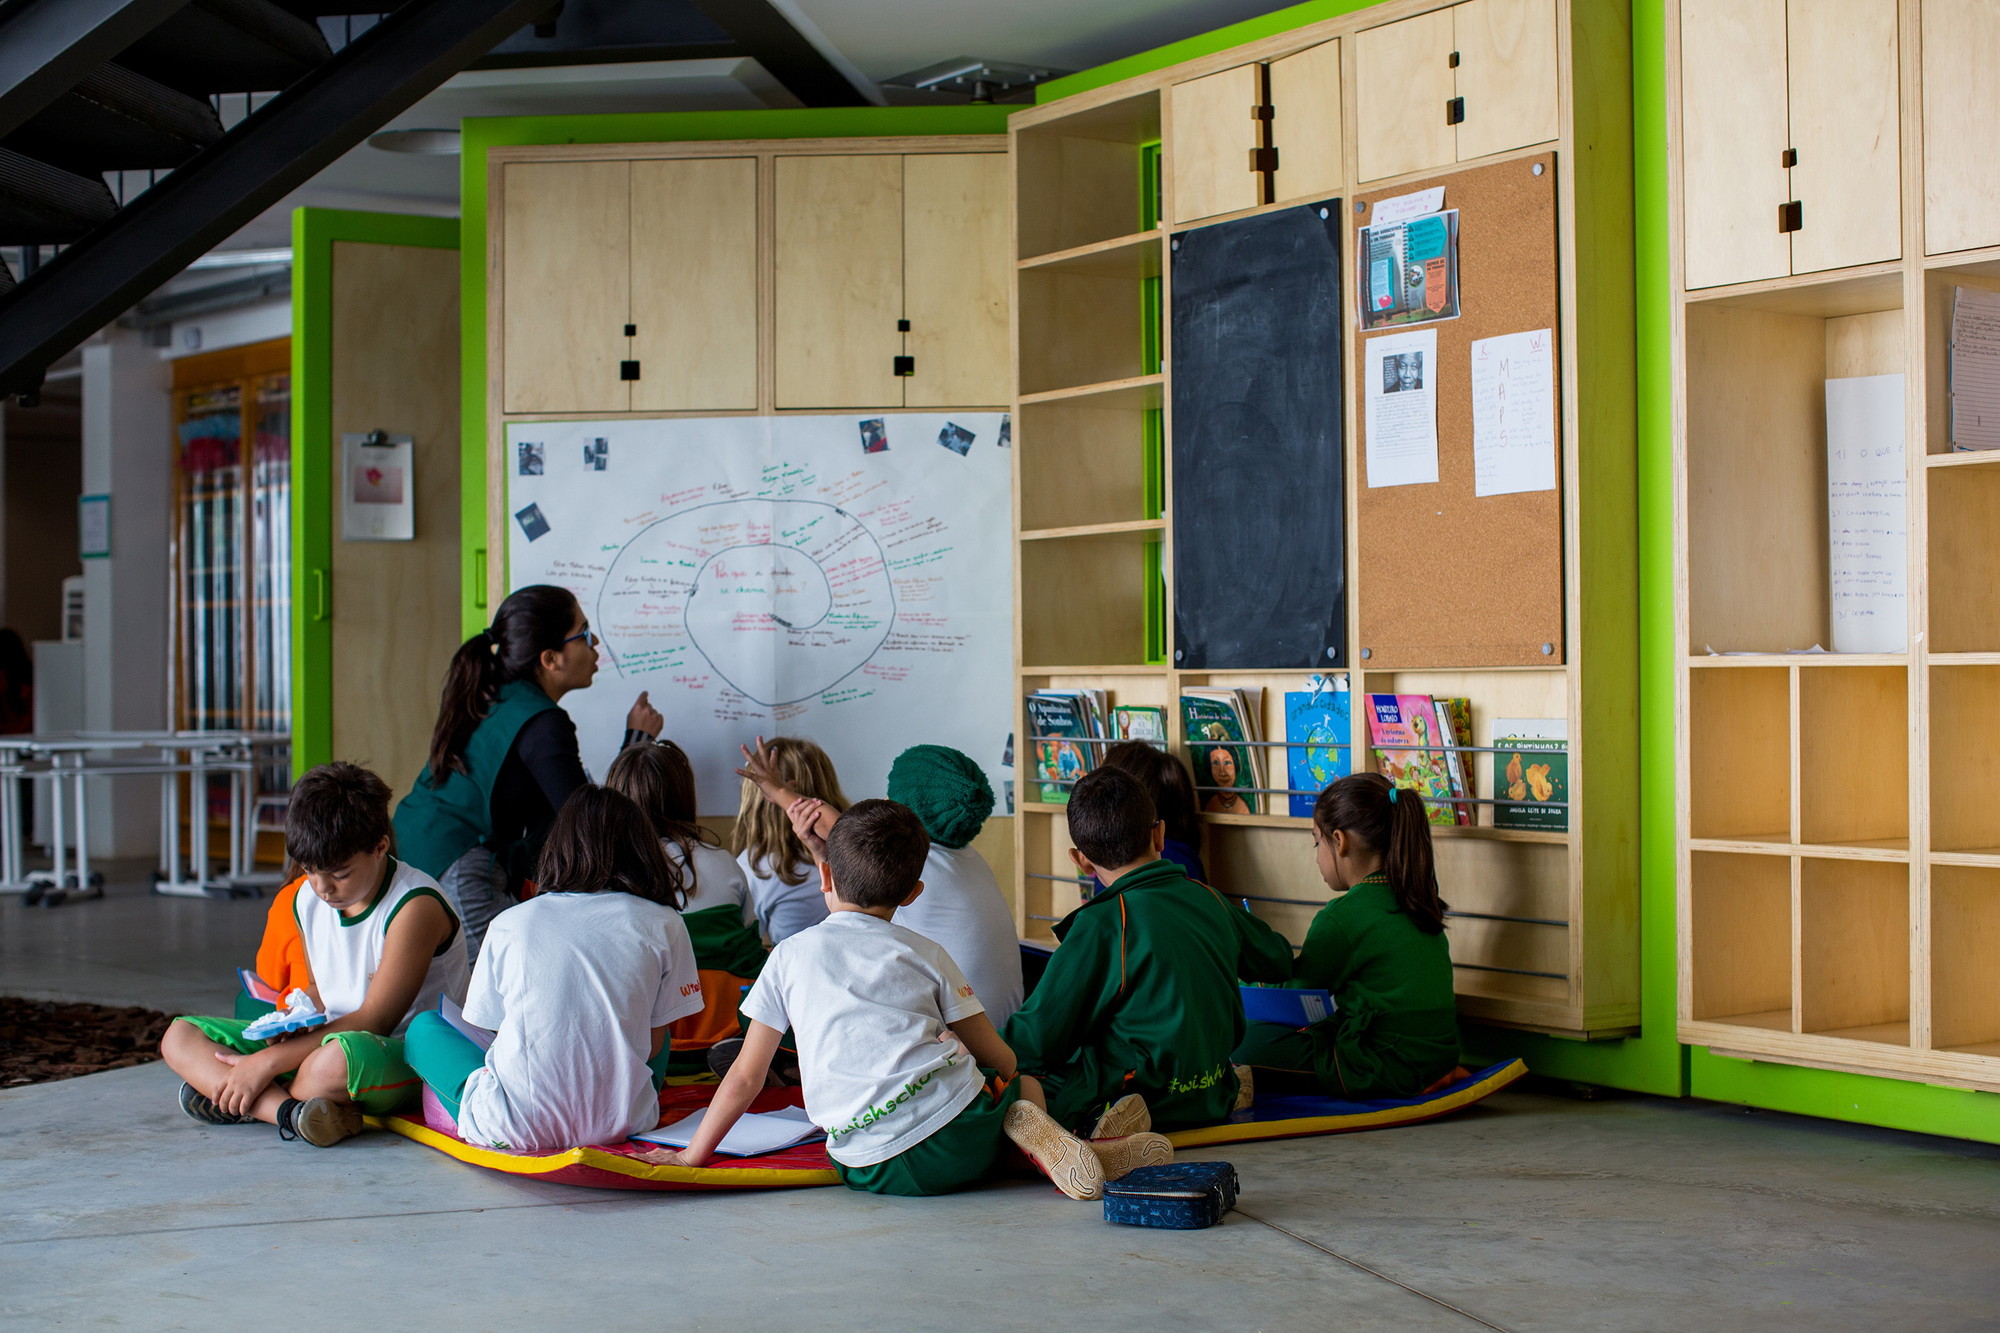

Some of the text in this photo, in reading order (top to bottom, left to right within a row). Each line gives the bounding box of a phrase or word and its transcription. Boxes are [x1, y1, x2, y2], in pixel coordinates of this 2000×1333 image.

[1028, 701, 1037, 713] O
[1037, 714, 1073, 726] de Sonhos
